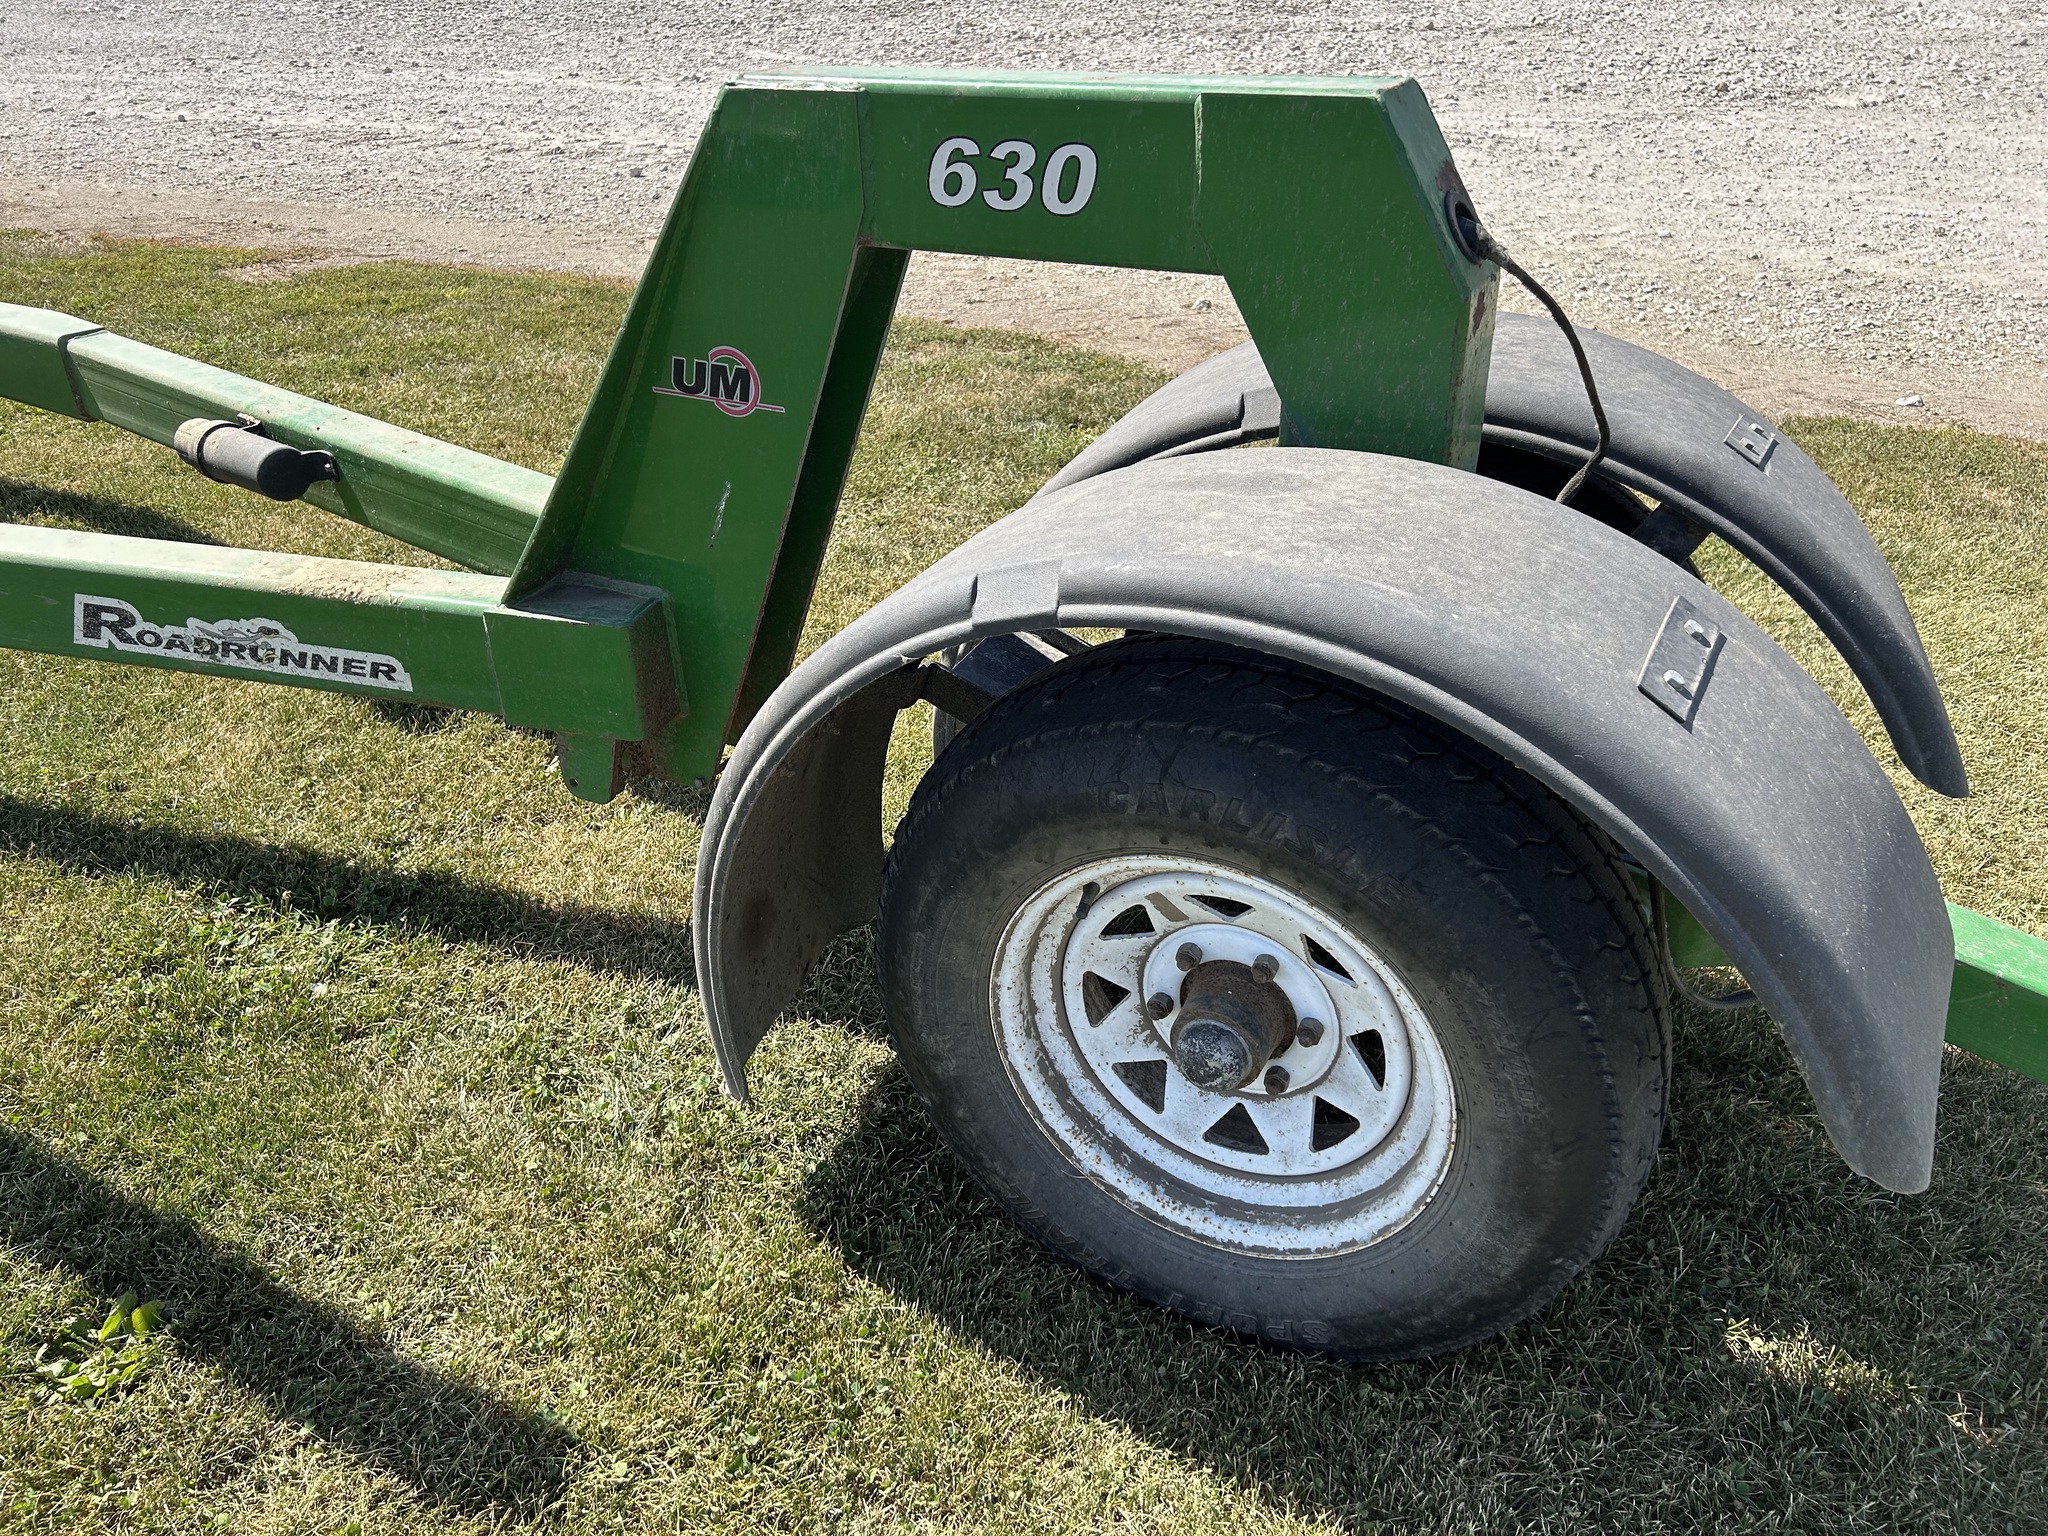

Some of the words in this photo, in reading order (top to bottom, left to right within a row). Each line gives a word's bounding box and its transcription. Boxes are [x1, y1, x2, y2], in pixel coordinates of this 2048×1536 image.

[927, 136, 1098, 217] 630
[671, 356, 754, 403] UM
[82, 601, 398, 682] ROADRUNNER
[1098, 780, 1414, 908] CARLISLE
[1004, 1184, 1132, 1288] TRAIL
[1166, 1292, 1331, 1344] SPORT
